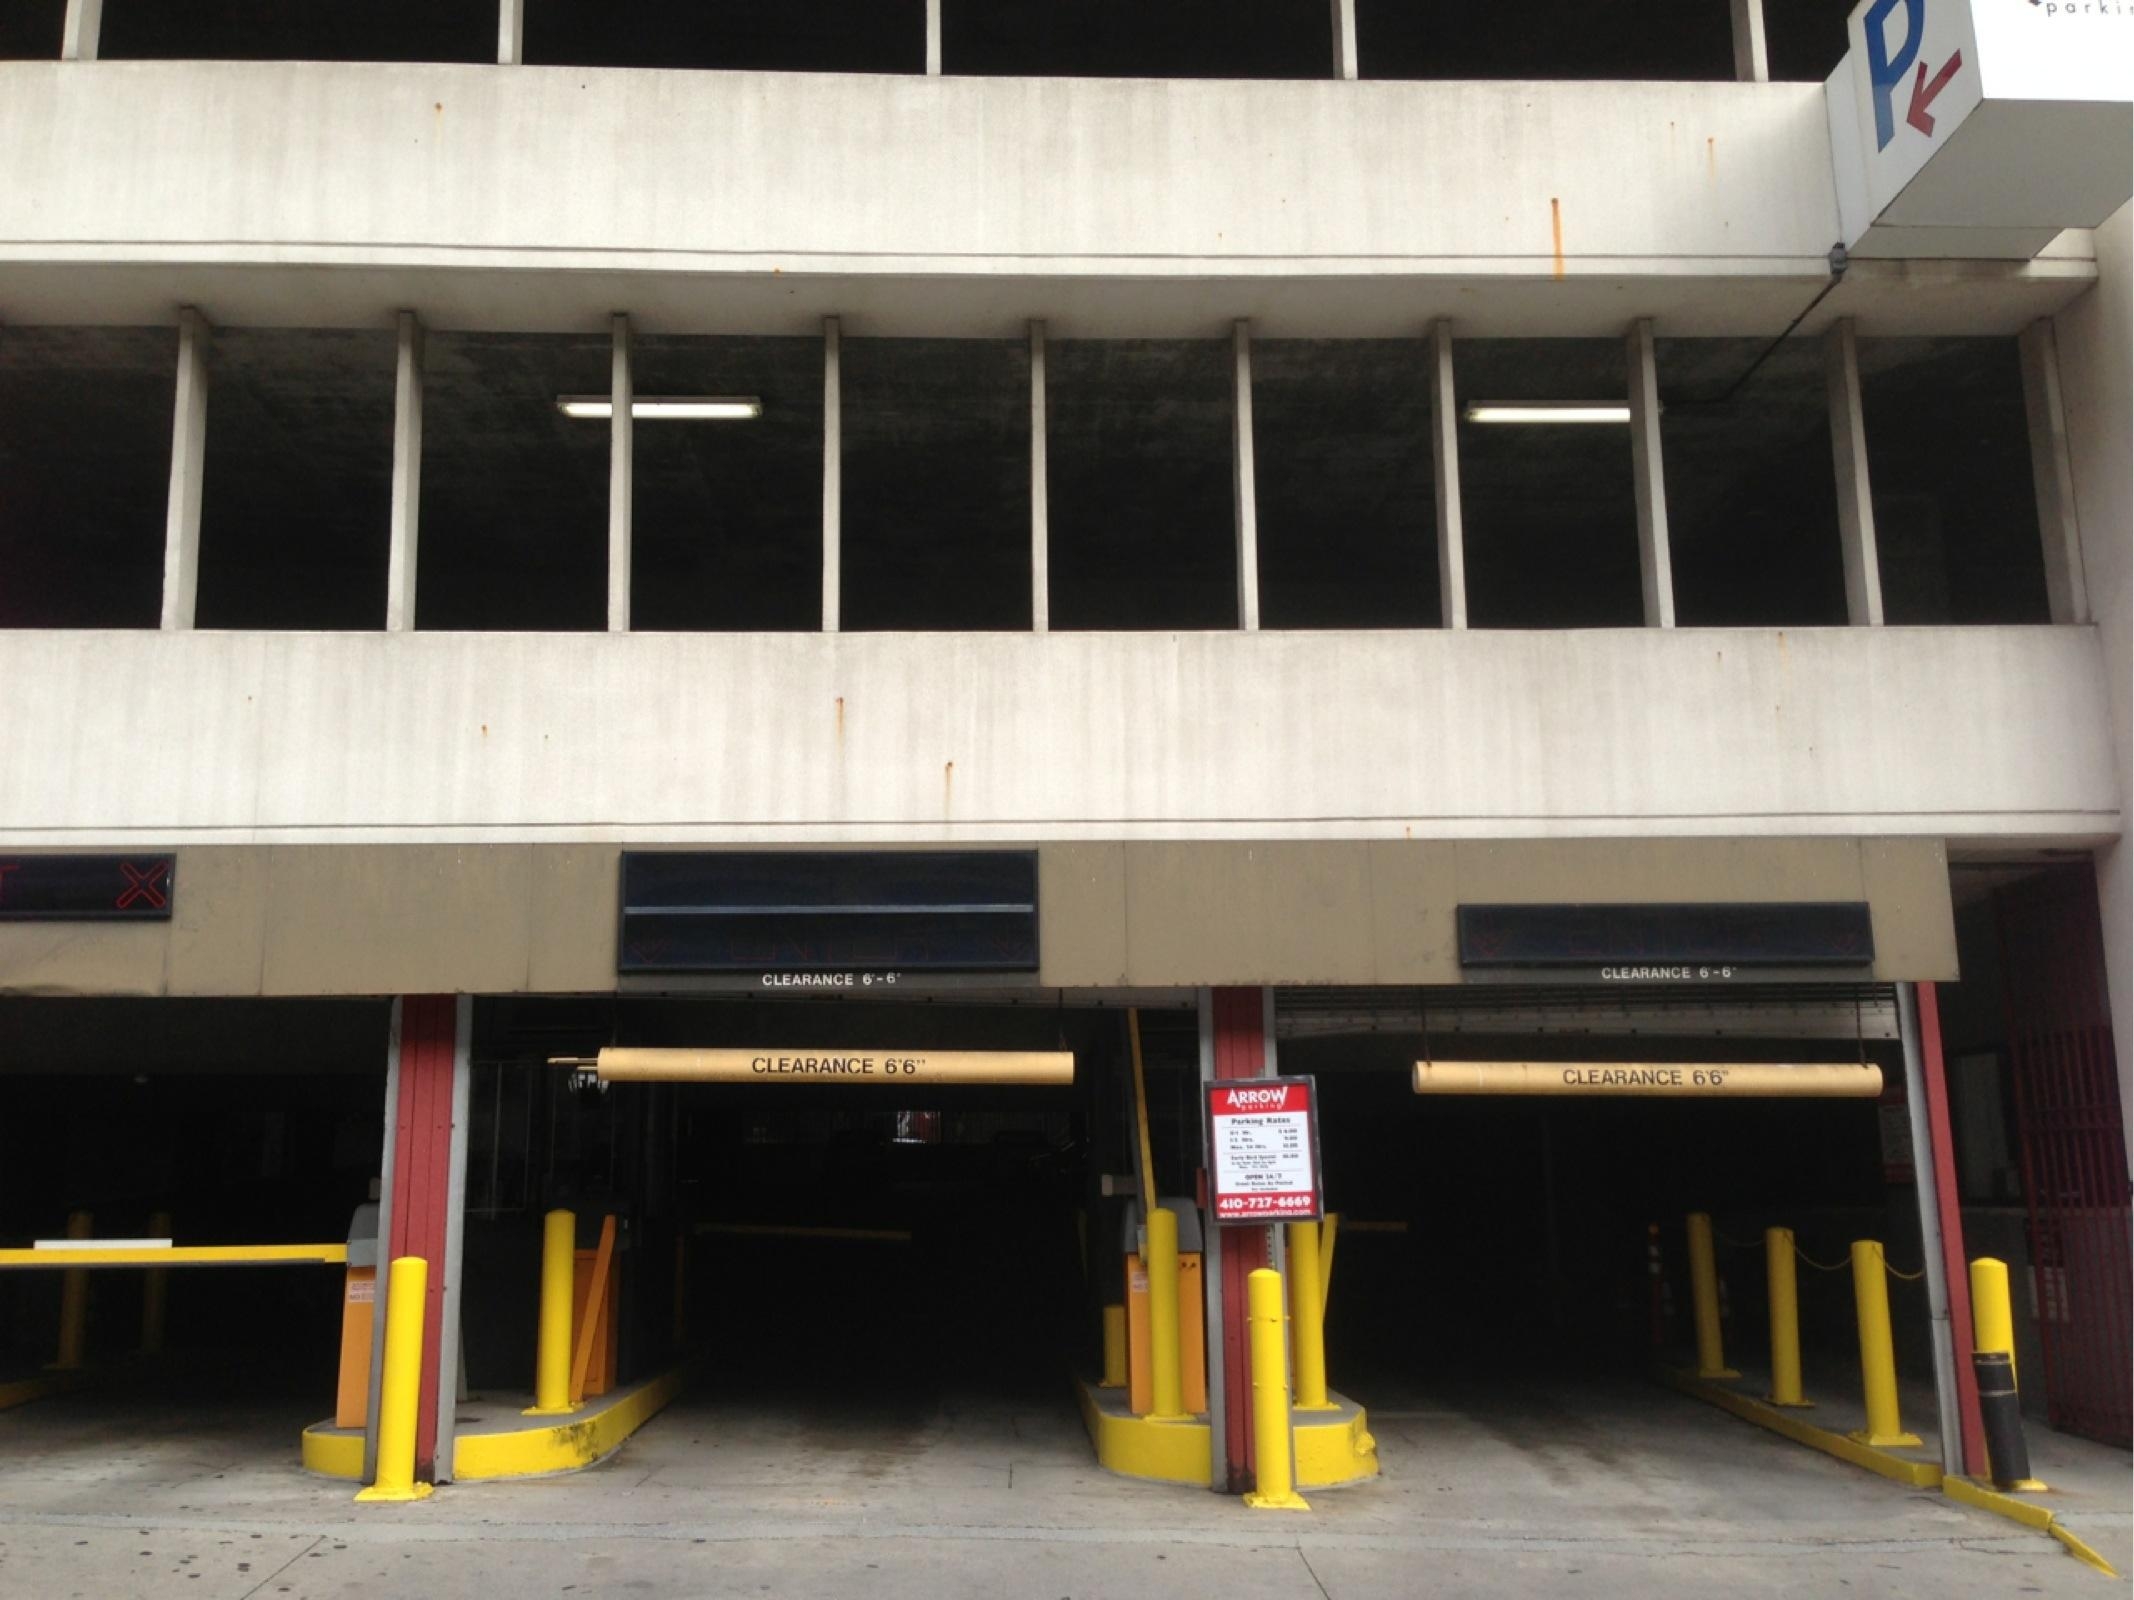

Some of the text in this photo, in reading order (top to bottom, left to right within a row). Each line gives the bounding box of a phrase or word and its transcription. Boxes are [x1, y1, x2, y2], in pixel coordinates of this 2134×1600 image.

[1863, 0, 1924, 153] P
[761, 972, 854, 986] CLEARANCE
[1601, 966, 1691, 980] CLEARANCE
[752, 1057, 874, 1074] CLEARANCE
[1563, 1068, 1683, 1086] CLEARANCE
[1227, 1085, 1288, 1108] ARROW
[1231, 1116, 1291, 1126] Parking Rates
[1219, 1196, 1311, 1209] 410-727-6669
